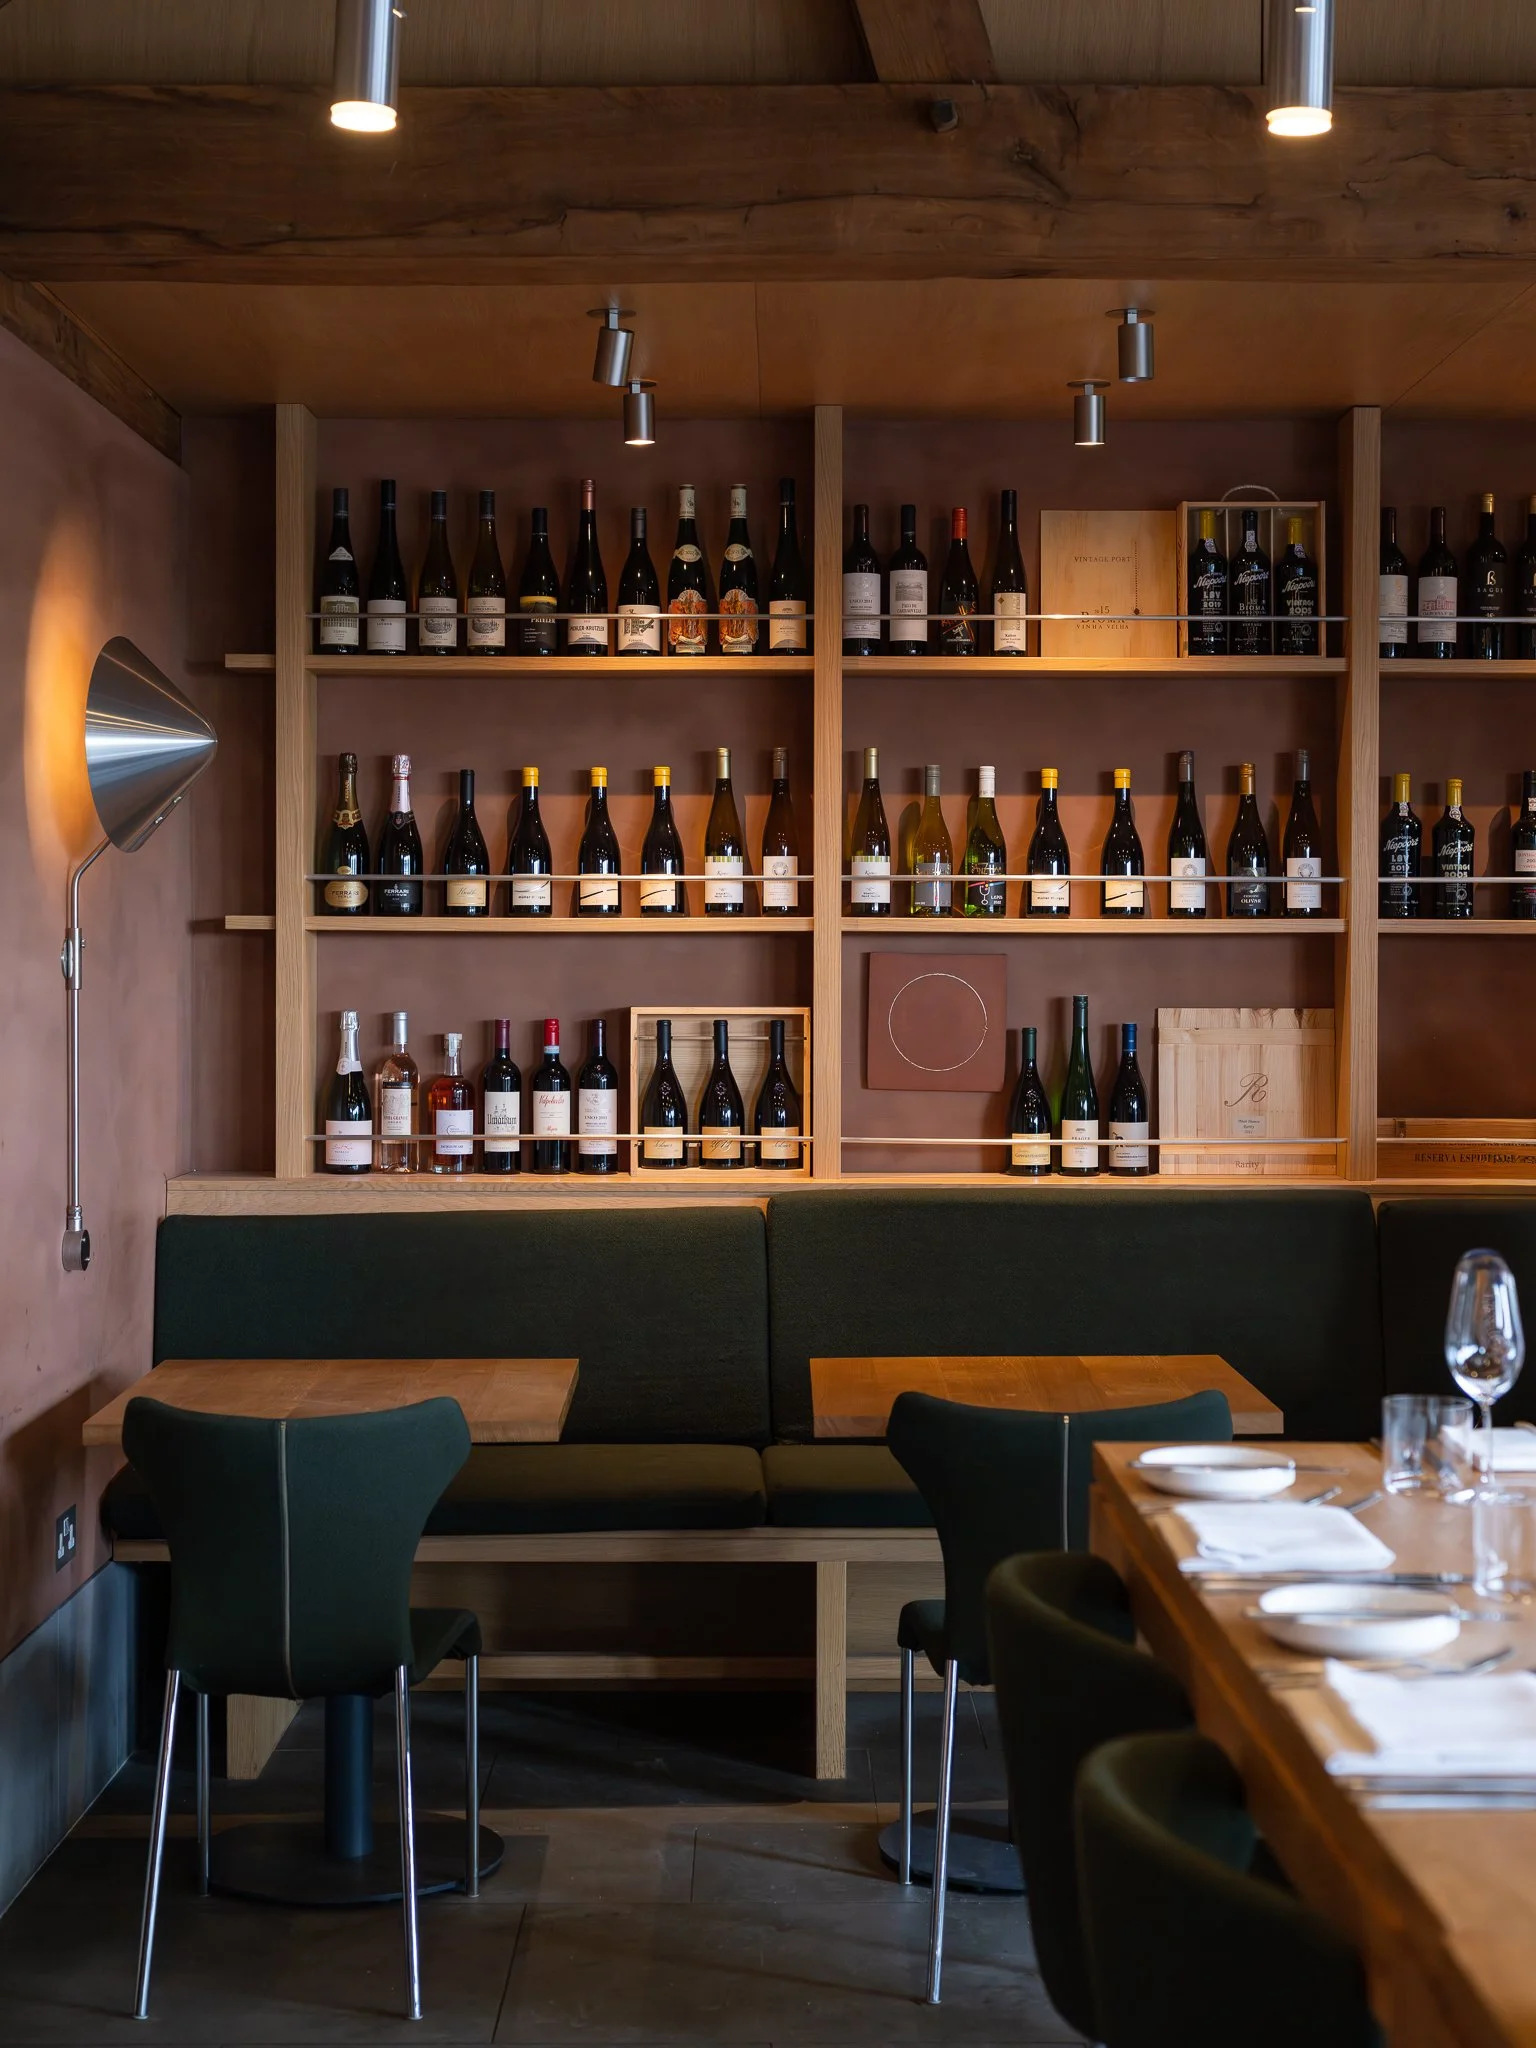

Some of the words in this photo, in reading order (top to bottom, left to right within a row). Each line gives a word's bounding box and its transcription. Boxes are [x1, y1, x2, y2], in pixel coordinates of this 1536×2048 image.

[1203, 591, 1221, 599] LBV
[1383, 836, 1420, 853] Niepoort
[1437, 842, 1475, 858] Niepoort
[1391, 854, 1410, 863] LBV
[1391, 864, 1410, 872] 2019
[1414, 1153, 1456, 1162] RESERVA
[1235, 1160, 1261, 1169] Rarity
